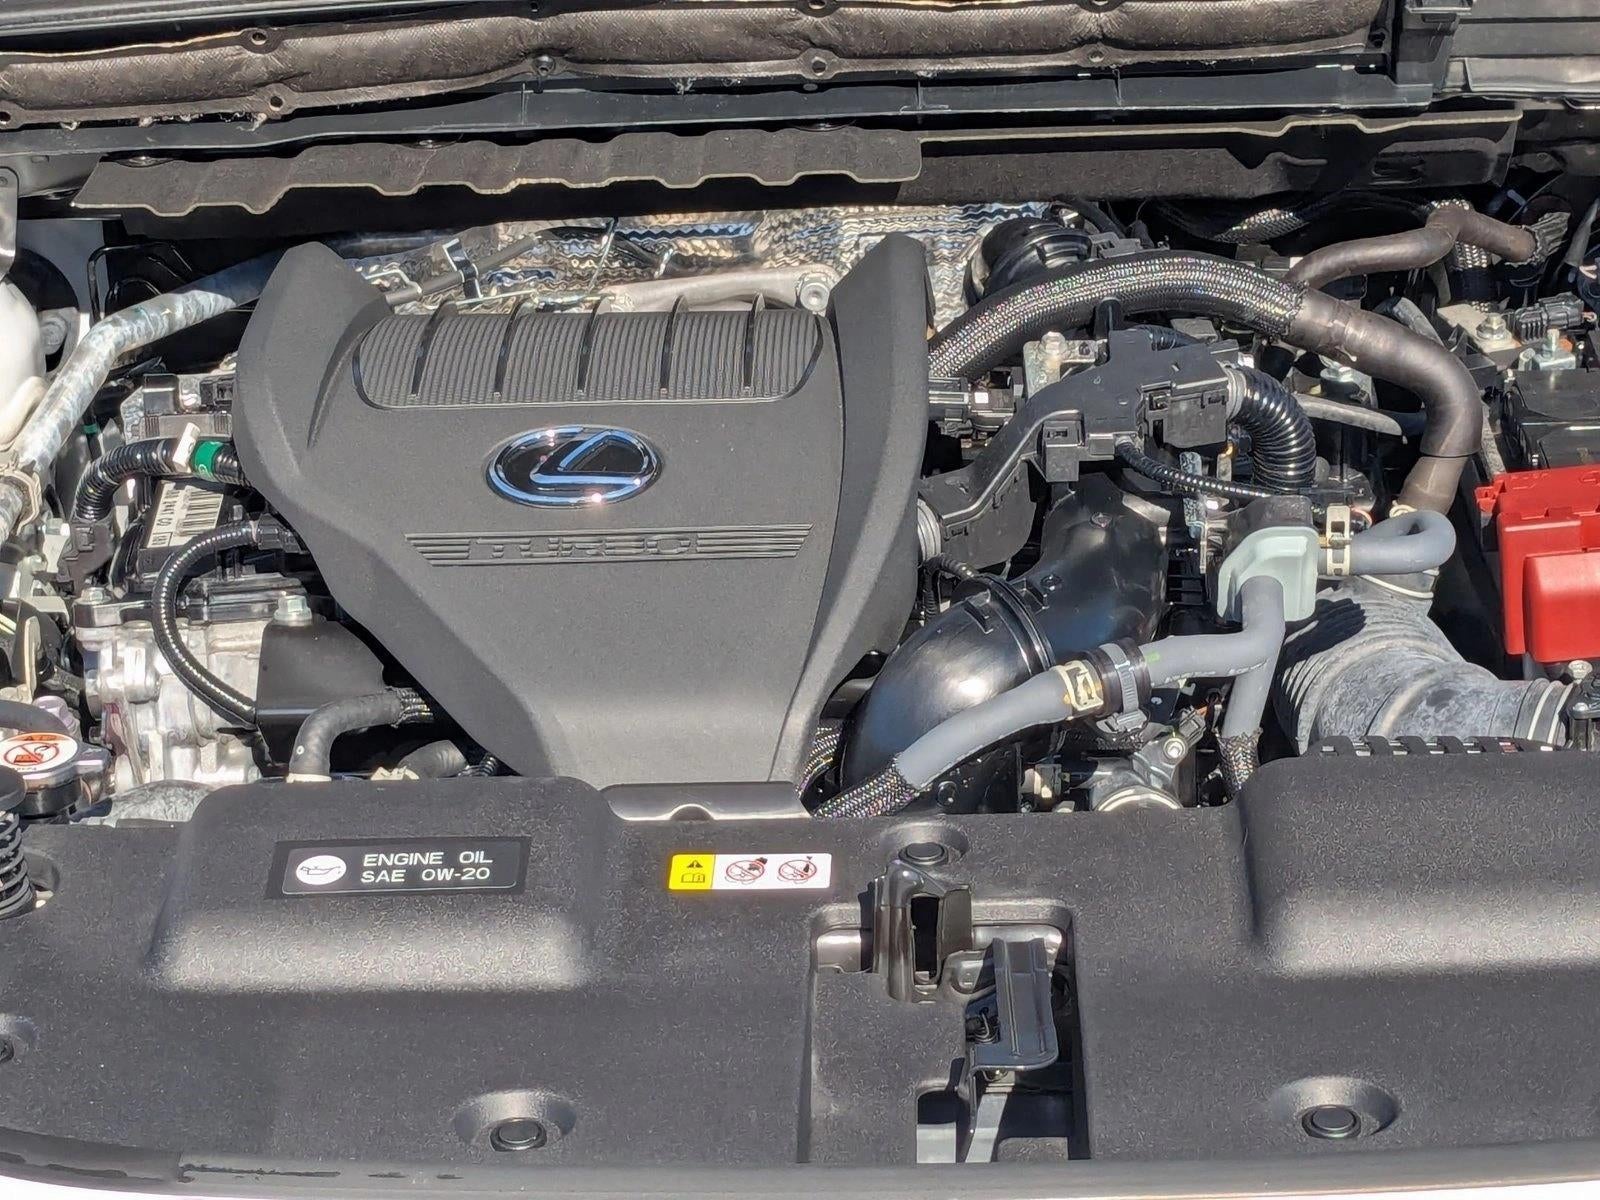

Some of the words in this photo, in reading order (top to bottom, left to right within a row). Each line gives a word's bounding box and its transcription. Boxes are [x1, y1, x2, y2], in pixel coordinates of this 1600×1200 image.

[475, 534, 691, 558] TURBO
[363, 852, 444, 867] ENGINE
[459, 850, 493, 865] OIL
[360, 869, 407, 883] SAE
